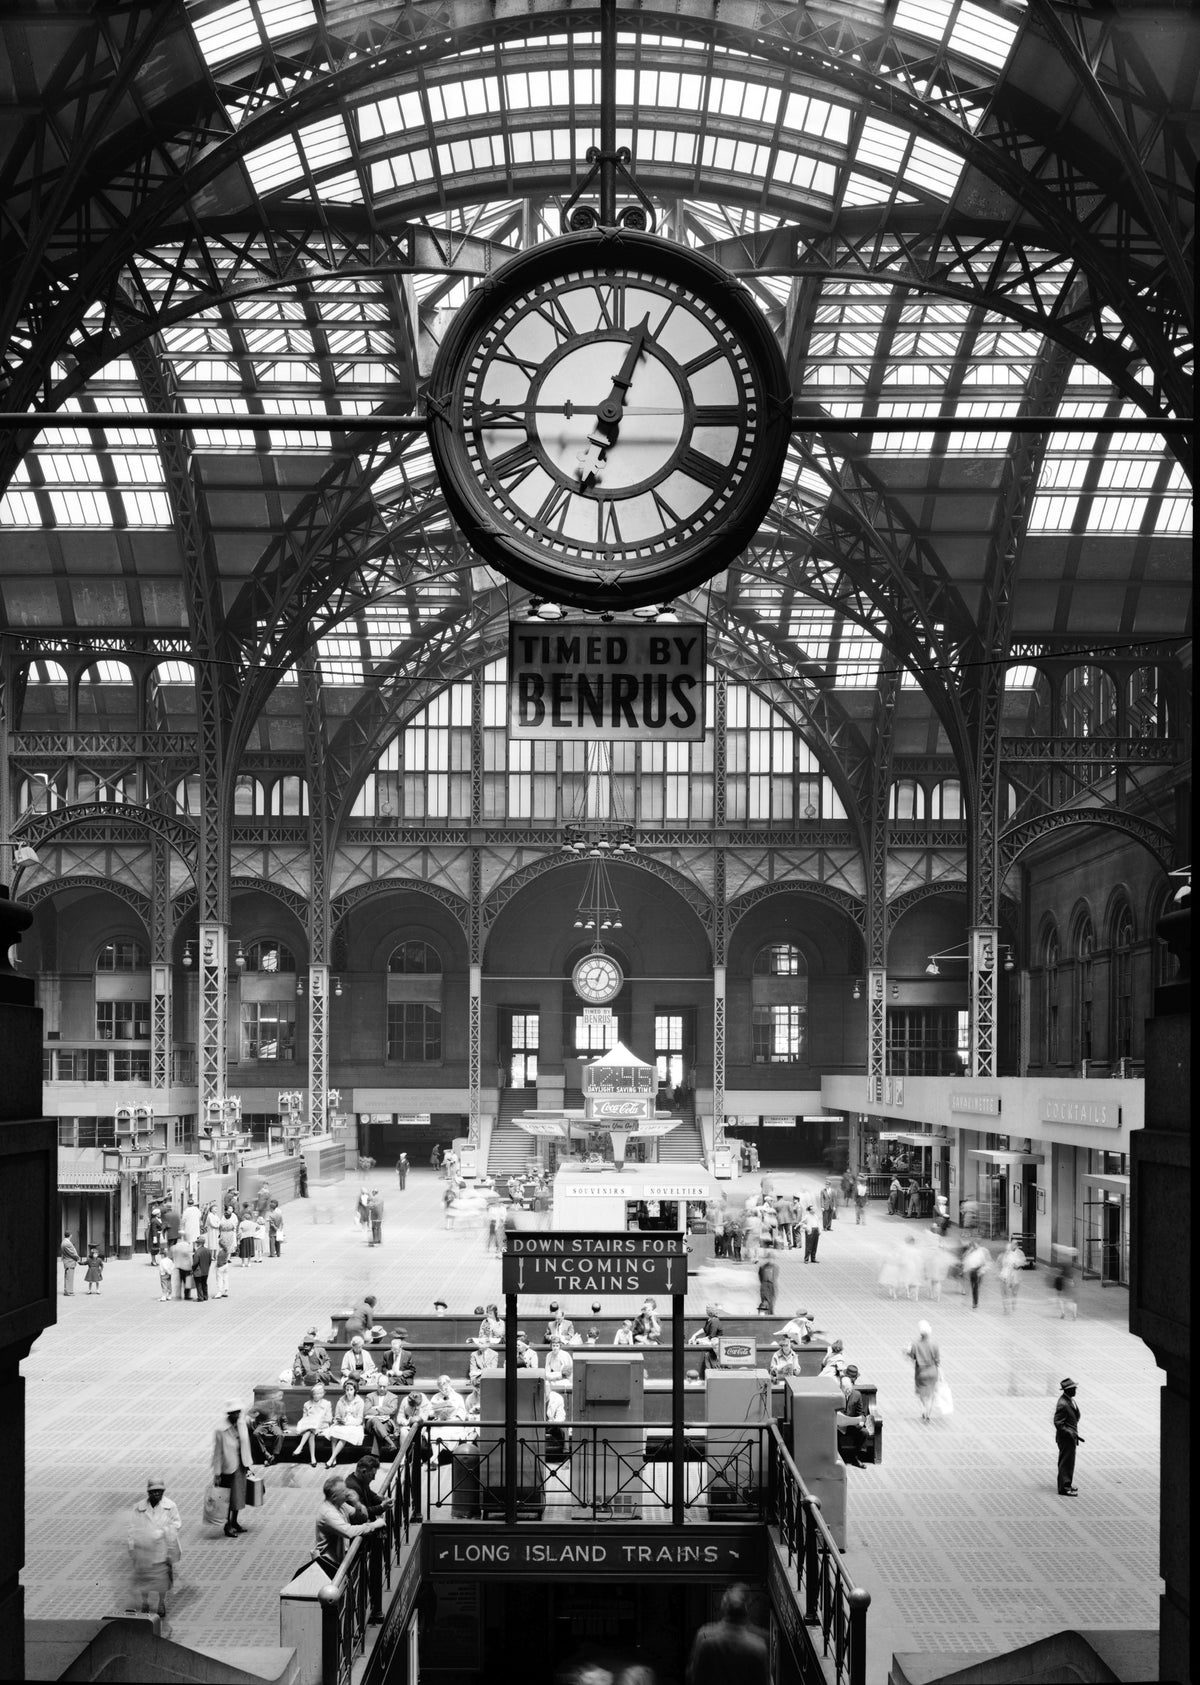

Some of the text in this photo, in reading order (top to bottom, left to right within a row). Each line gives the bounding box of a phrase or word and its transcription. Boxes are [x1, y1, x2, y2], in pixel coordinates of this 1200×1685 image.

[518, 636, 698, 665] TIMED BY
[518, 672, 698, 729] BENRUS
[584, 1015, 611, 1023] BENRUS
[589, 1067, 652, 1086] 12:45
[1046, 1102, 1107, 1124] COCKTAILS
[513, 1239, 677, 1252] DOWN STAIRS FOR
[535, 1258, 656, 1273] INCOMING
[554, 1276, 640, 1290] TRAINS
[454, 1545, 719, 1562] LONG ISLAND TRAINS
